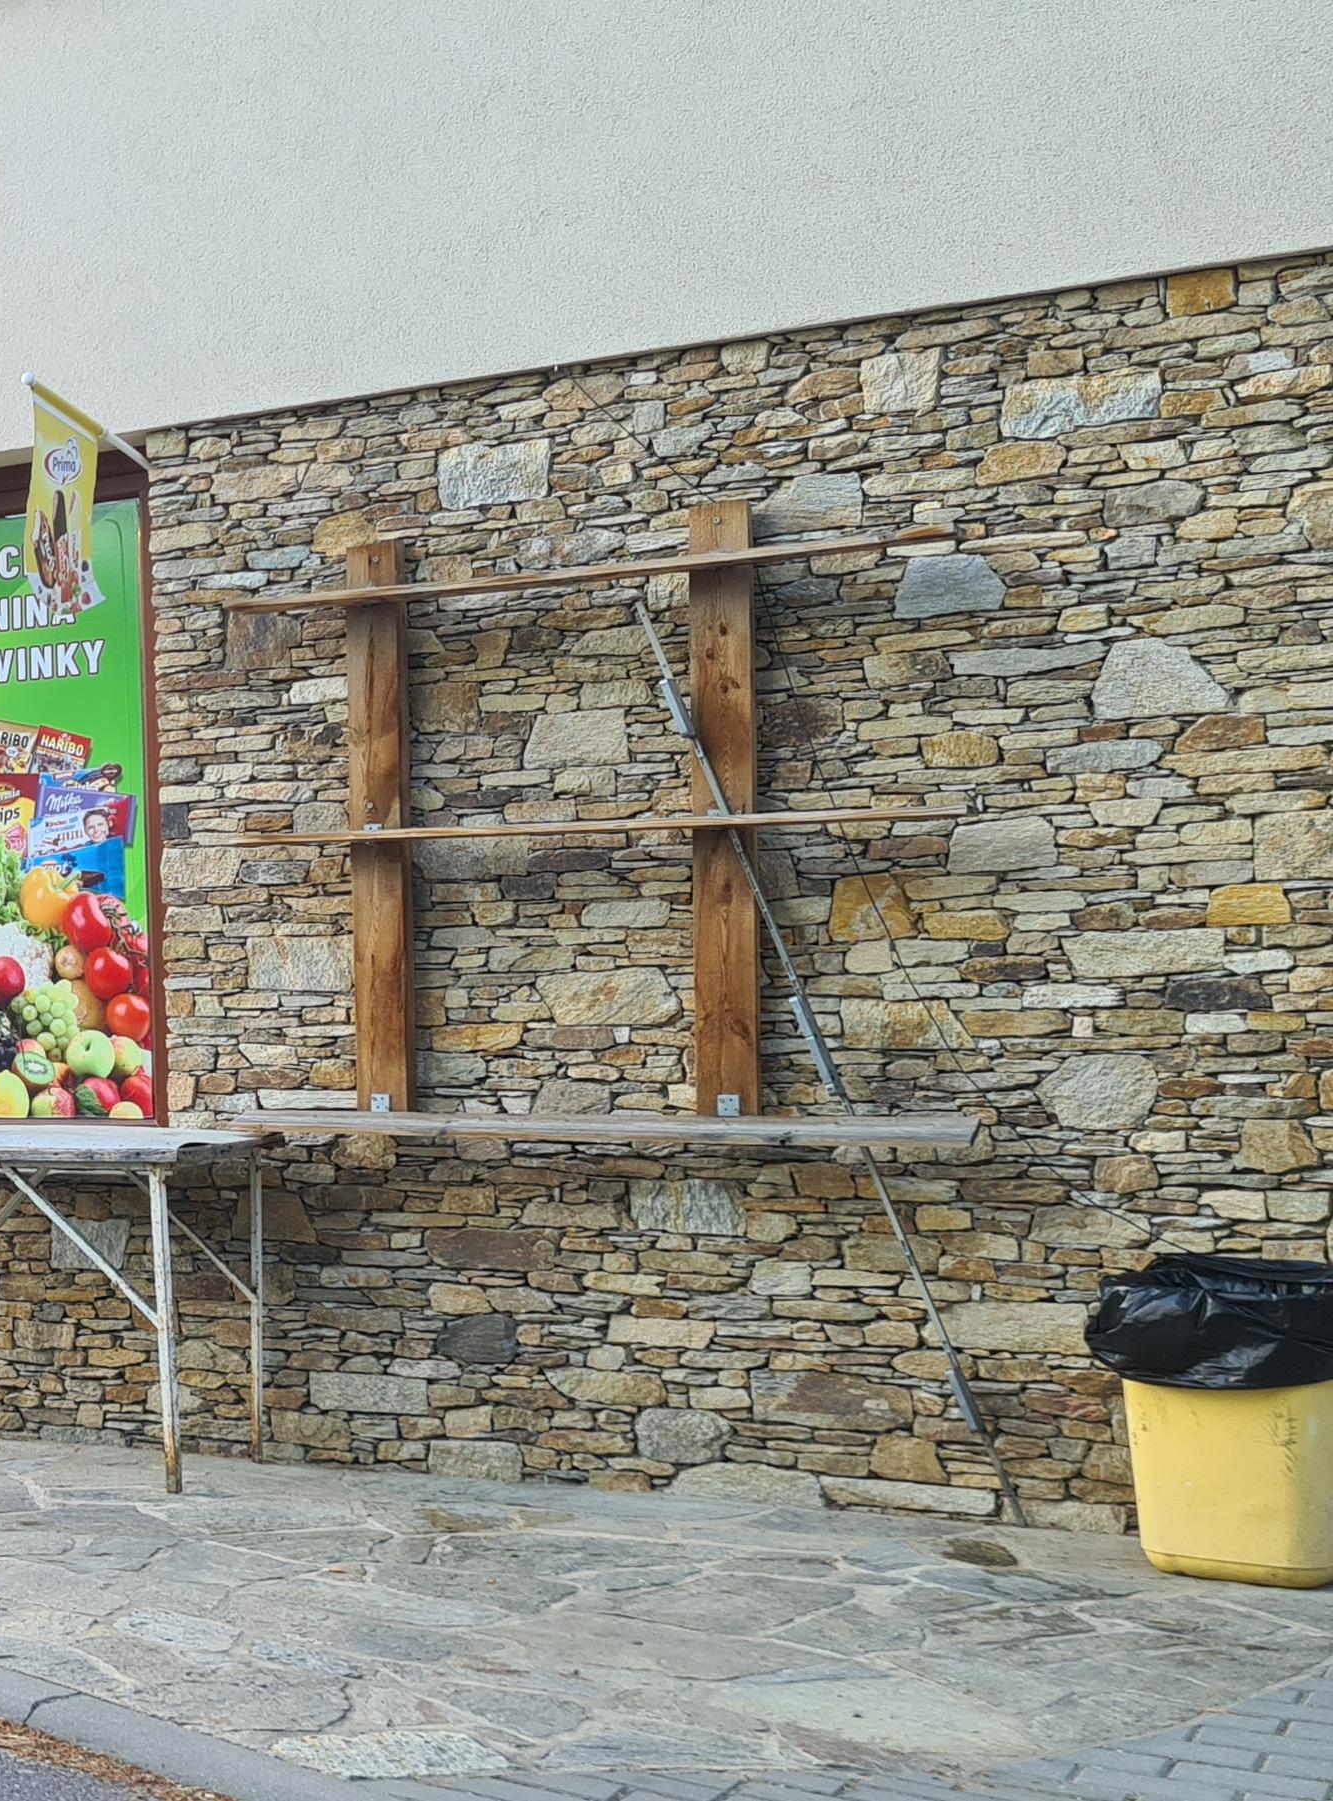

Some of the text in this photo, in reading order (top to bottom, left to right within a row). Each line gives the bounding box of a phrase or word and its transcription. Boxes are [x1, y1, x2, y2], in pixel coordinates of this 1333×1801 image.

[52, 455, 76, 473] Prima
[40, 734, 84, 757] HARIBO
[45, 792, 84, 812] Milka
